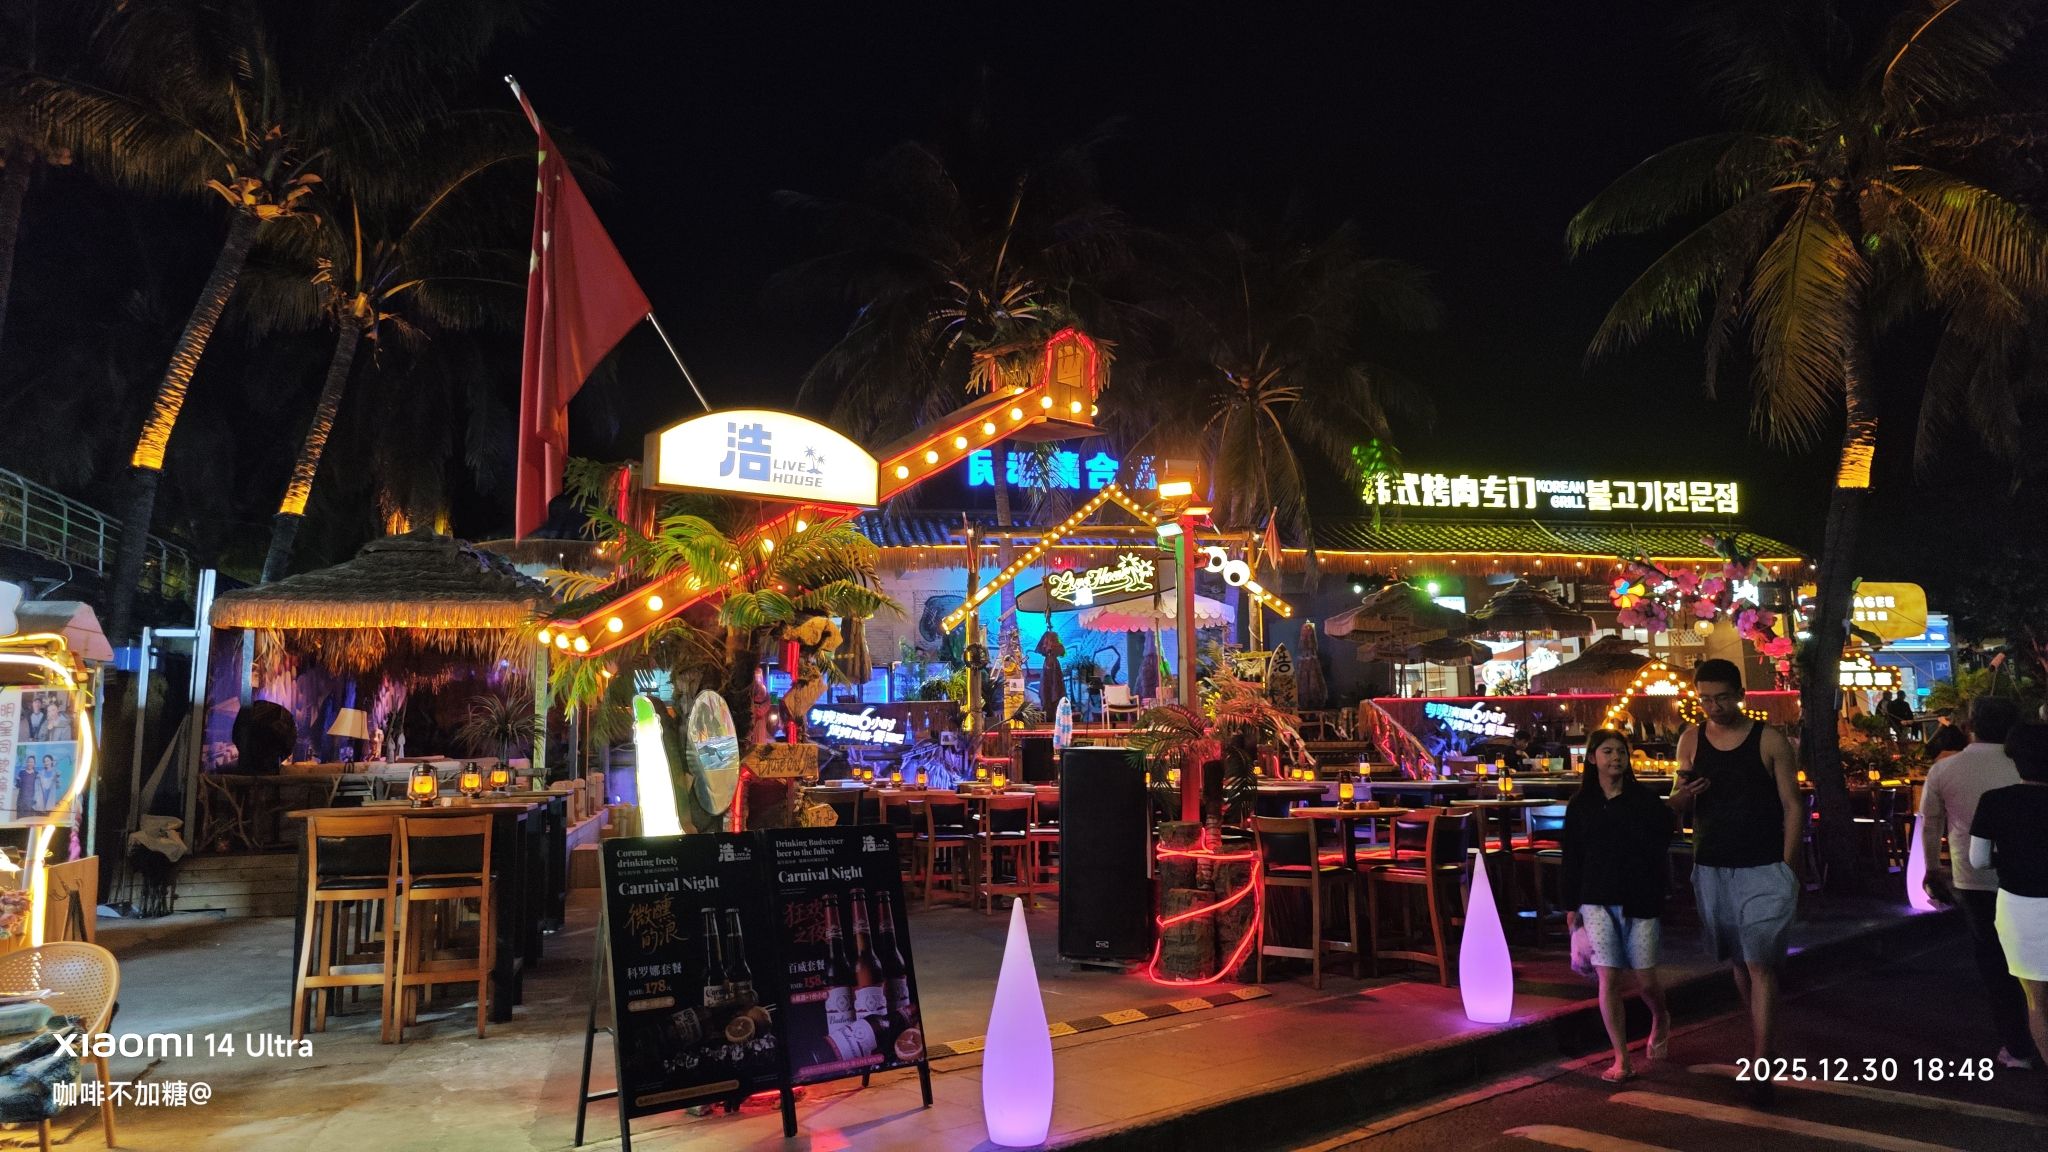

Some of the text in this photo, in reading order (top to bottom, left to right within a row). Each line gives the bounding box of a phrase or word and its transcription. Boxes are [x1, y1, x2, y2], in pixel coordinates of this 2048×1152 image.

[719, 421, 772, 482] 浩
[773, 458, 807, 472] LIVE
[773, 472, 824, 488] HOUSE
[1536, 479, 1586, 495] KOREAN
[1550, 495, 1586, 509] GRILL
[1586, 479, 1739, 514] 불고기전문점
[776, 848, 793, 858] beer
[801, 847, 812, 856] the
[812, 846, 836, 856] fullest
[617, 855, 679, 868] drinking freely
[777, 865, 864, 884] Carnival Night
[618, 874, 721, 896] Carnival Night
[627, 961, 684, 980] 科罗娜套餐
